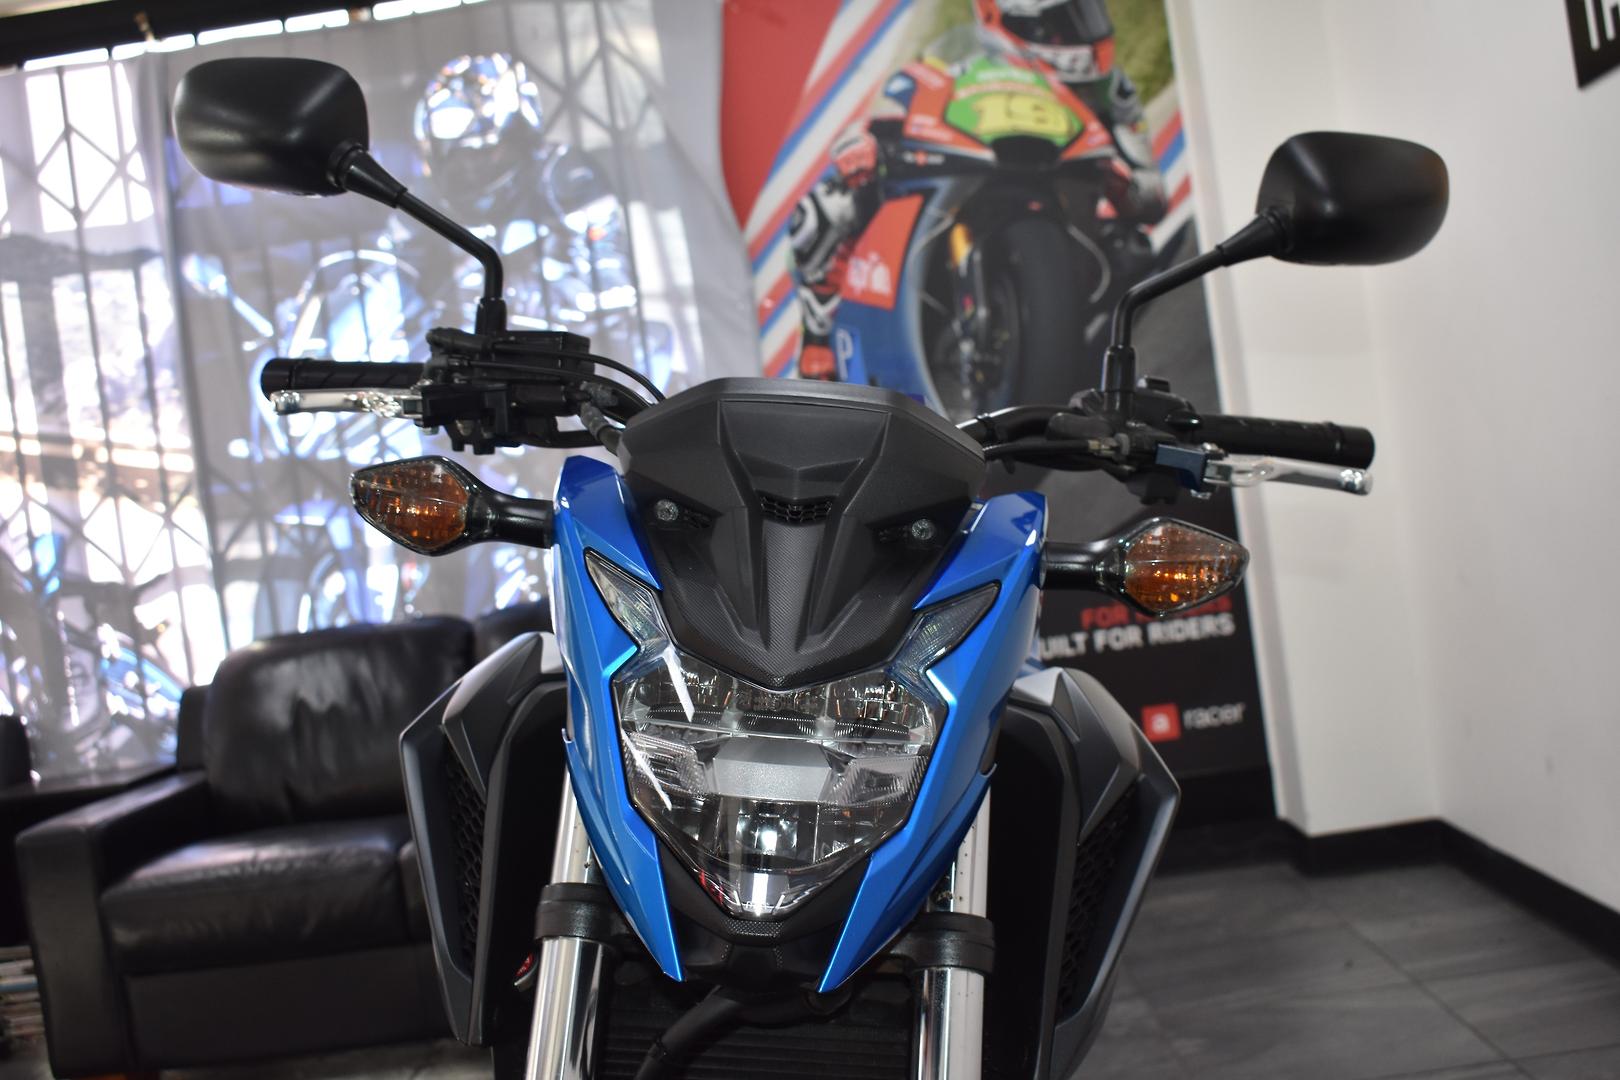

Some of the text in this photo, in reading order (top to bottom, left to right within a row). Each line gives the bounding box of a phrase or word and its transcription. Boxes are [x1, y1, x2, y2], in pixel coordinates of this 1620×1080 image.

[1080, 601, 1130, 630] FOR
[1040, 612, 1235, 661] UILT FOR RIDERS
[1183, 703, 1245, 730] racer
